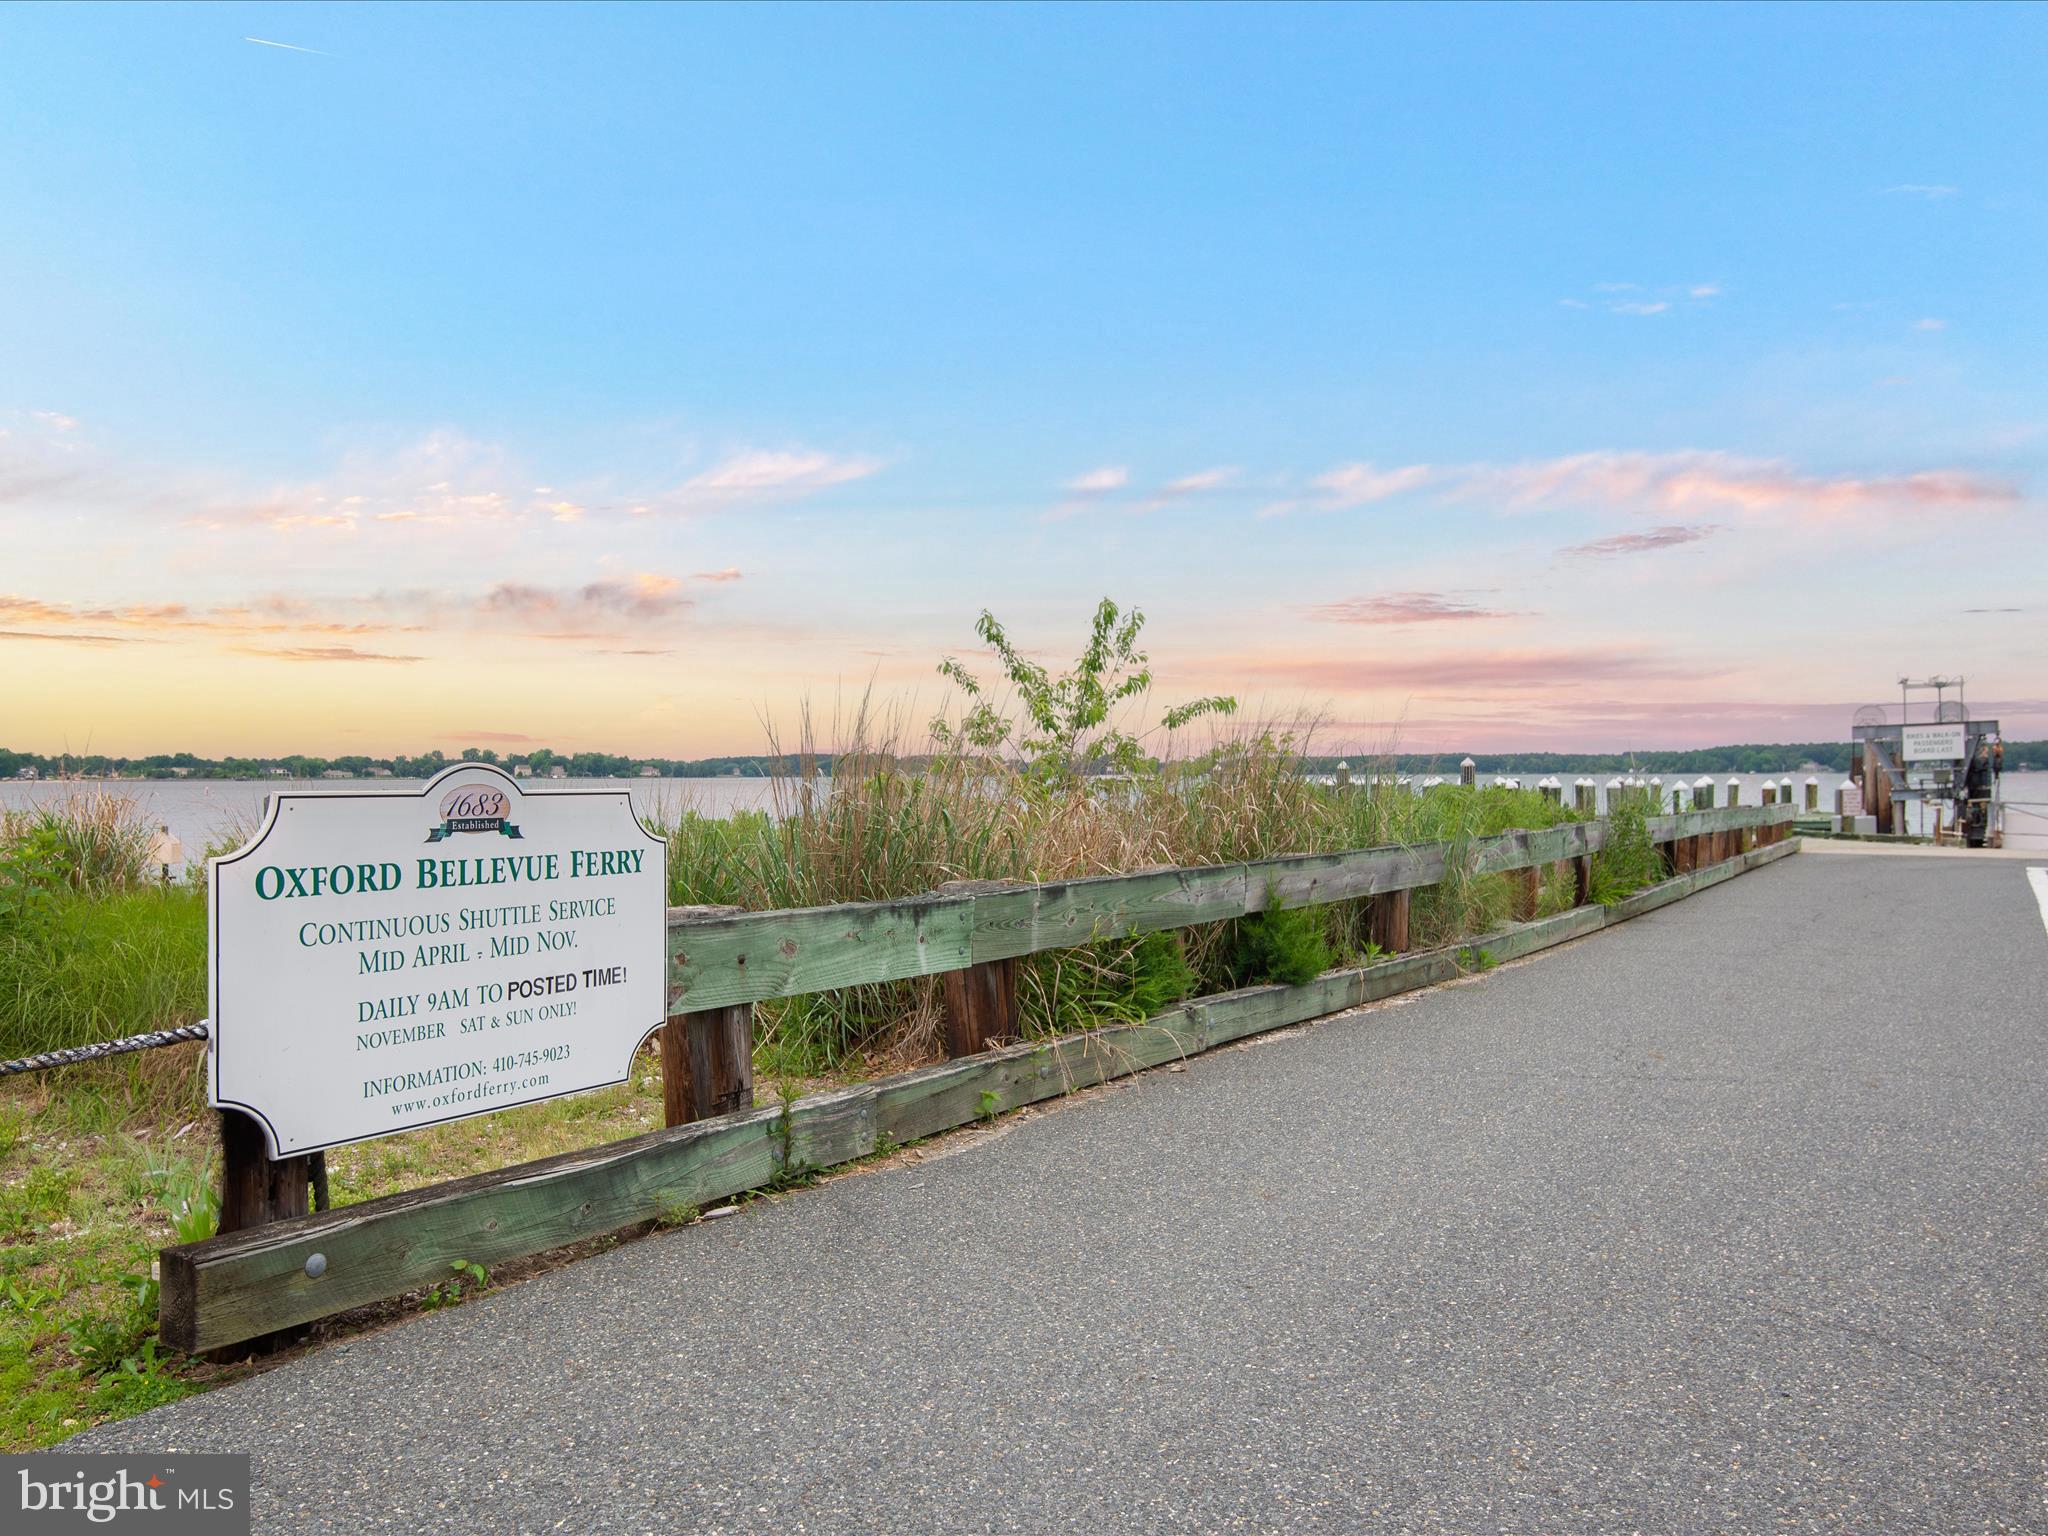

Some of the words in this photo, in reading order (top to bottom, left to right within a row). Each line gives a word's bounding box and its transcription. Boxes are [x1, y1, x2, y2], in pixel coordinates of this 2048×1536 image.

[446, 793, 503, 817] 1683
[451, 820, 500, 831] Established
[255, 863, 402, 900] OXFORD
[416, 854, 560, 889] BELLEVUE
[570, 849, 645, 878] FERRY
[299, 912, 450, 947] CONTINUOUS
[459, 904, 542, 931] SHUTTLE
[549, 897, 616, 921] SERVICE
[358, 949, 405, 975] MID
[412, 943, 470, 968] APRIL
[490, 936, 530, 958] MID
[537, 930, 578, 952] NOV.
[358, 995, 420, 1023] DAILY
[427, 987, 470, 1012] 9AM
[477, 983, 503, 1005] TO
[508, 973, 577, 1000] POSTED
[582, 966, 627, 988] TIME!
[356, 1022, 446, 1051] NOVEMBER
[460, 1016, 486, 1034] SAT
[490, 1016, 500, 1029] &
[505, 1008, 534, 1026] SUN
[538, 1001, 577, 1021] ONLY!
[363, 1060, 487, 1098] INFORMATION:
[492, 1044, 571, 1073] 410-745-9023
[391, 1073, 550, 1116] www.oxfordferry.com
